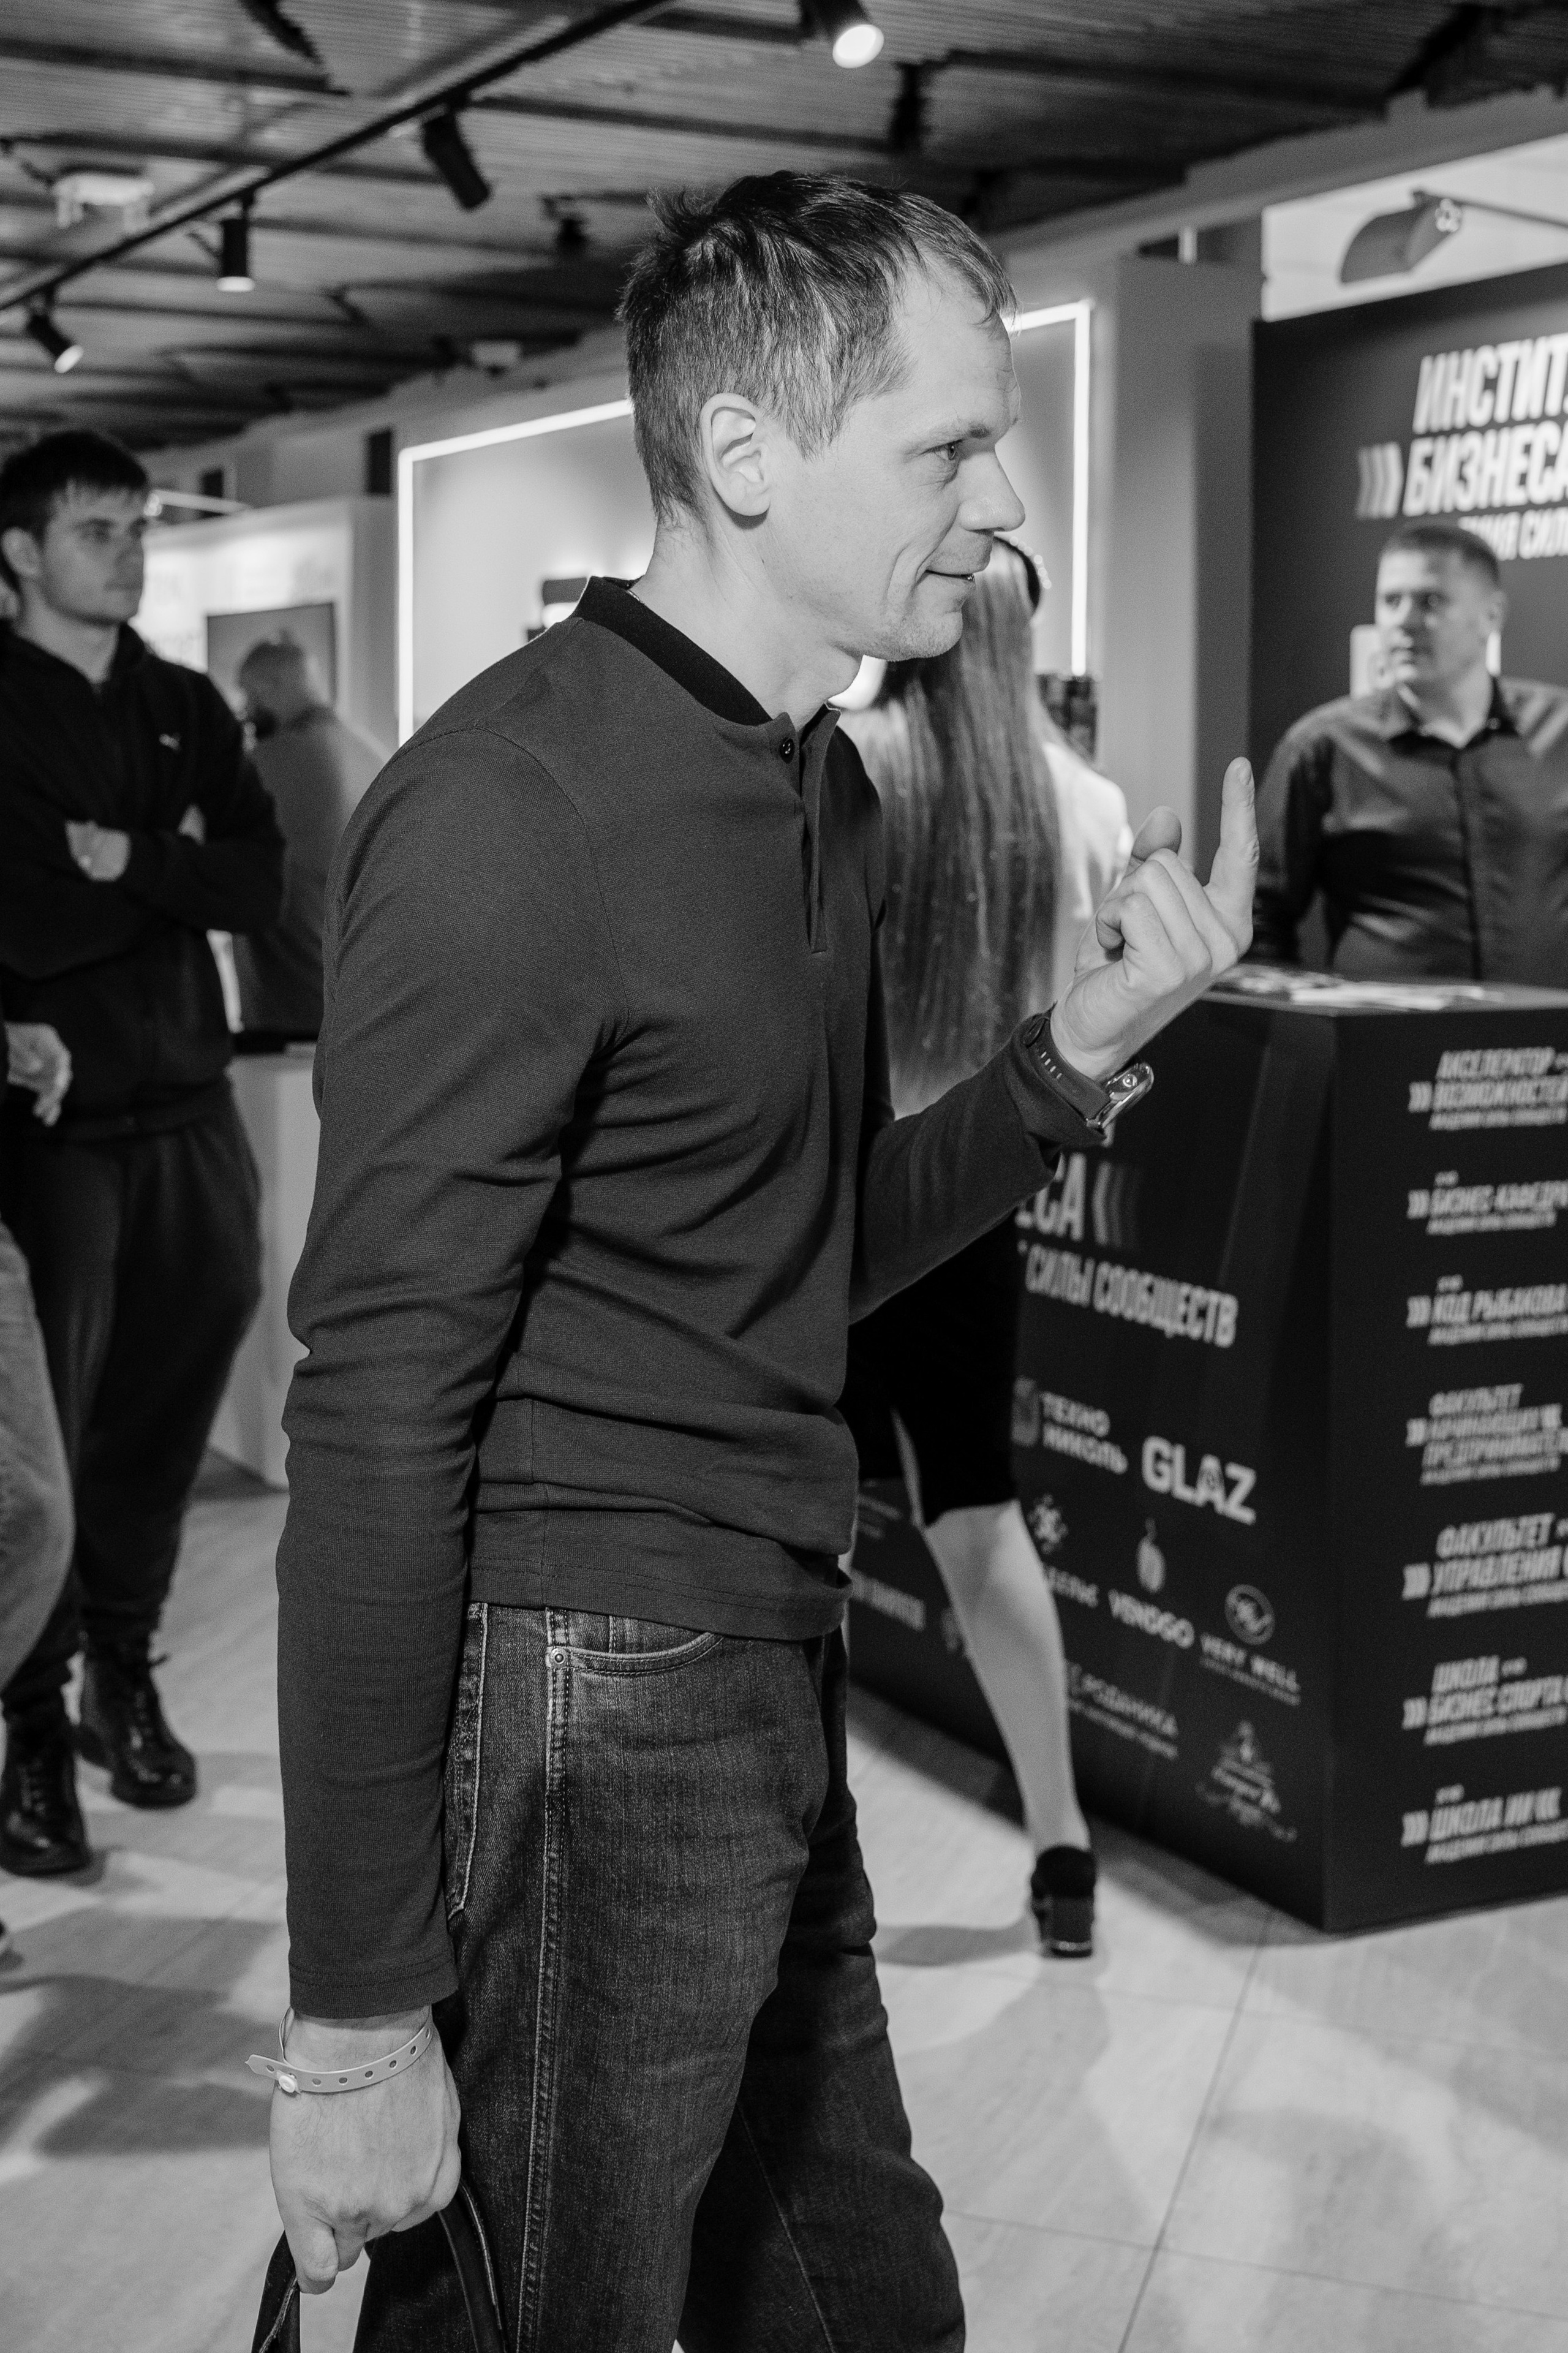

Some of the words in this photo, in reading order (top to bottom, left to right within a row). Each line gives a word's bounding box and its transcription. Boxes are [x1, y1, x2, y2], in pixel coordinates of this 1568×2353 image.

[1412, 332, 1568, 434] ИНСТИТ
[1025, 1244, 1095, 1309] СИЛЫ
[1093, 1261, 1238, 1348] СООБЩЕСТВ
[1142, 1435, 1256, 1525] GLAZ
[1436, 1513, 1555, 1558] ФАКУЛЬТЕТ
[1200, 1631, 1247, 1667] VERY
[1250, 1654, 1302, 1693] WELL
